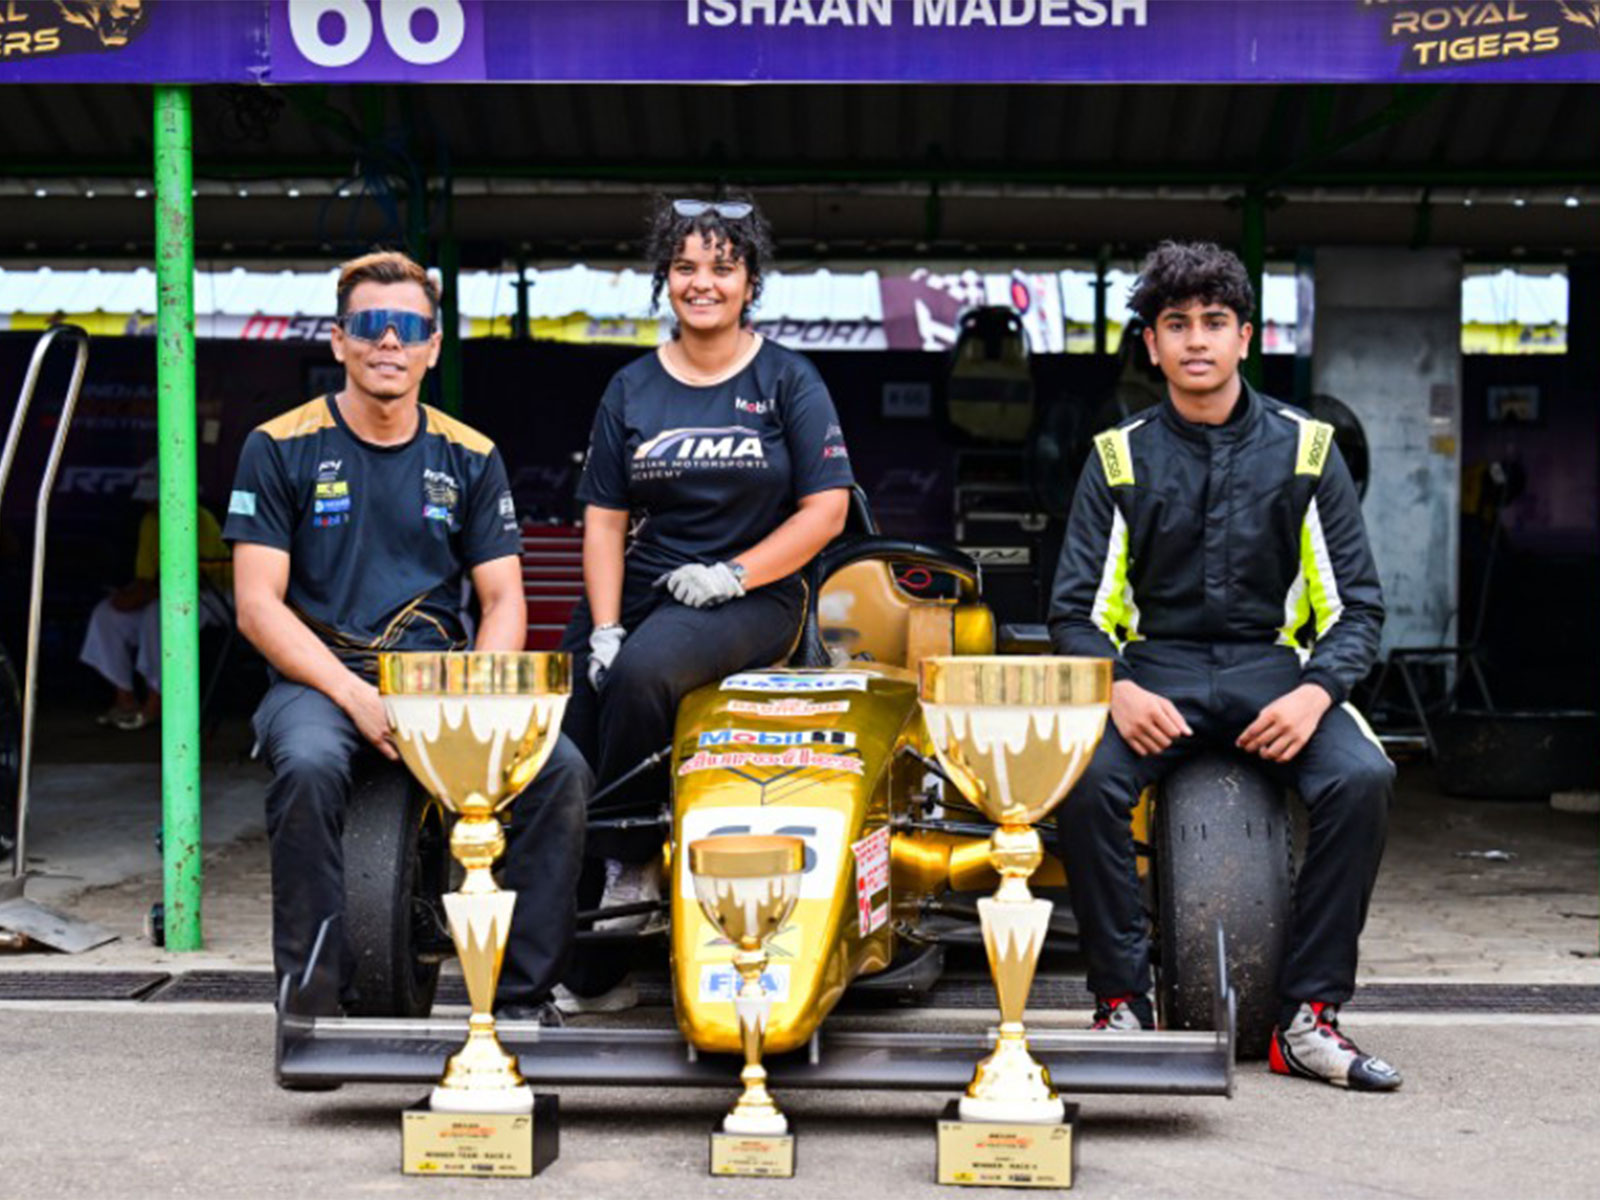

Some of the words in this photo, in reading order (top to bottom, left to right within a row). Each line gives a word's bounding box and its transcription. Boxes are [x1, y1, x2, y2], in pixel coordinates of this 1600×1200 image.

[687, 0, 892, 26] ISHAAN
[913, 0, 1148, 26] MADESH
[1391, 0, 1528, 35] ROYAL
[288, 0, 466, 67] 66
[1413, 27, 1560, 65] TIGERS
[676, 437, 764, 459] IMA
[699, 730, 803, 745] Mobil
